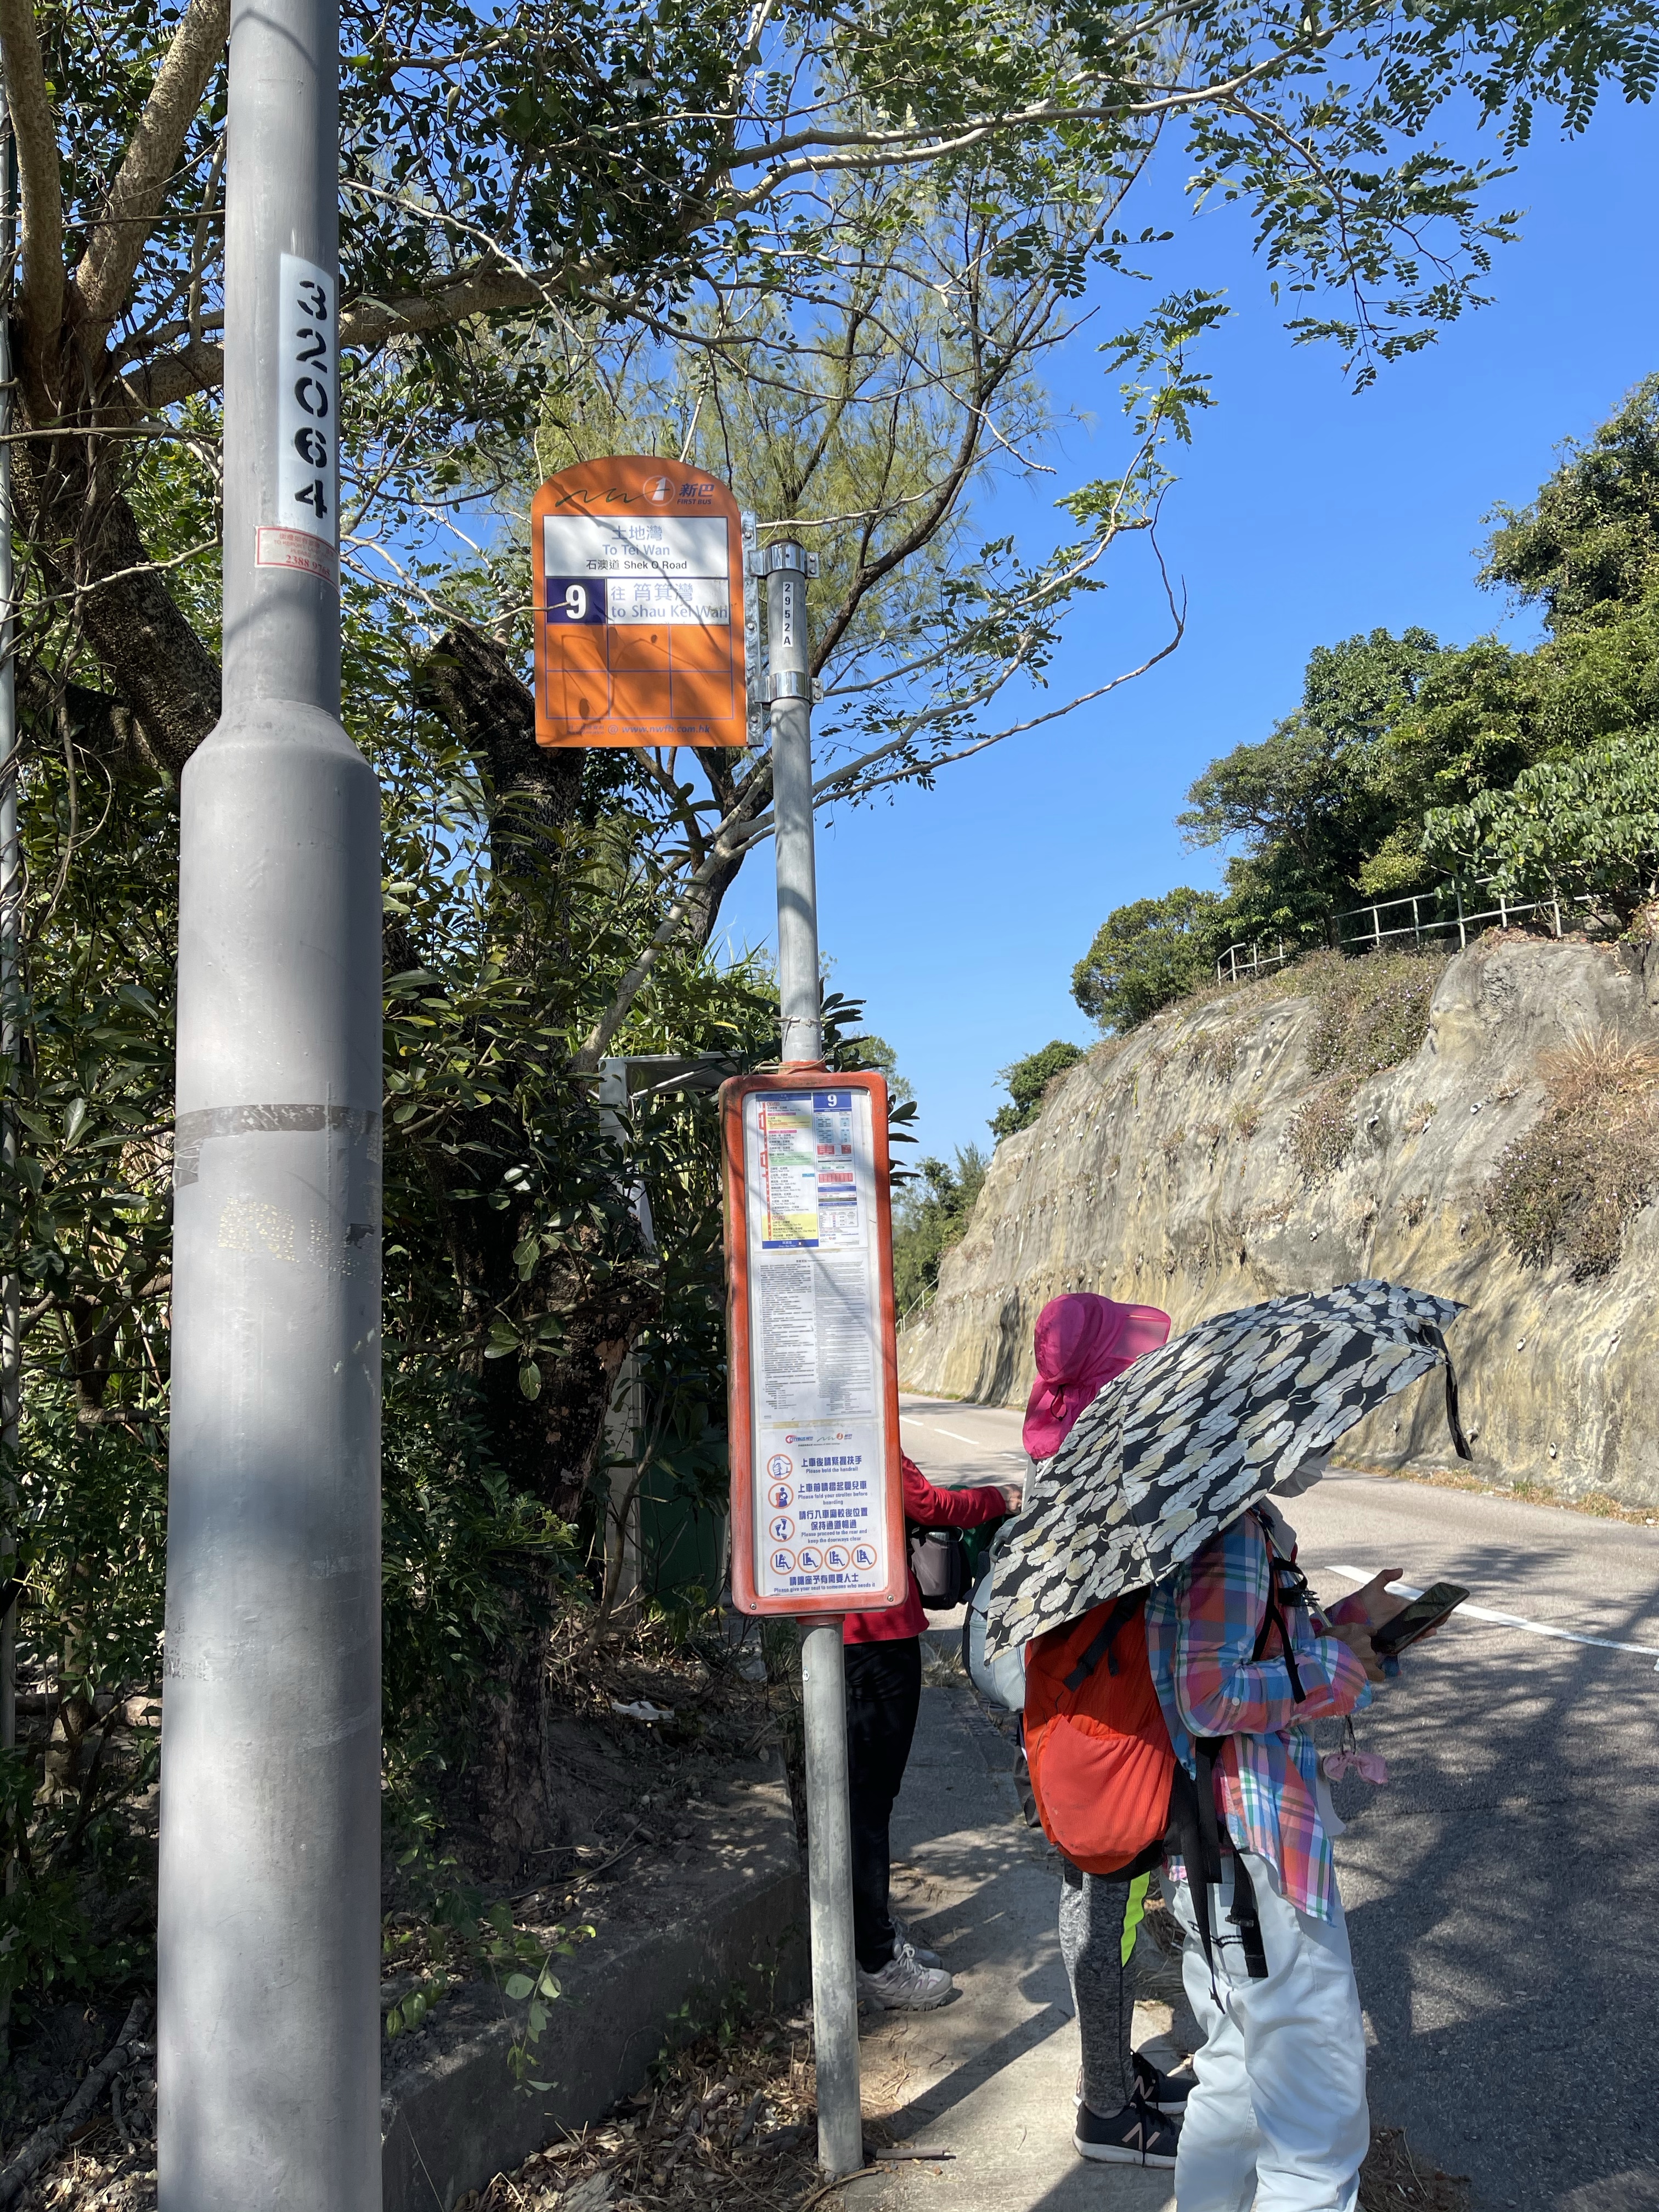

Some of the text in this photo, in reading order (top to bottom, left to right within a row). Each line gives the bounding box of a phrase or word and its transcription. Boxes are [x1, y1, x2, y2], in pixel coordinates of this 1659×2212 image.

[295, 280, 328, 519] 32064
[679, 483, 715, 498] 新巴
[611, 525, 663, 541] 土地灣
[602, 544, 670, 555] To Tei Wan
[286, 555, 309, 567] 2388
[586, 559, 687, 571] 石澳道 Shek O Road
[611, 583, 693, 601] 往 筲箕灣
[565, 584, 587, 619] 9
[612, 605, 728, 618] to Shau Kei Wan
[622, 725, 710, 733] www.nwfb.com.hk
[827, 1094, 837, 1107] 9
[801, 1455, 862, 1468] 上車後請緊握扶手
[798, 1481, 867, 1492] 上車前請摺起嬰兒車
[799, 1508, 868, 1520] 請行入車廂較後位置
[811, 1520, 857, 1531] 保持通道暢通
[789, 1573, 859, 1585] 請讓座予有需要人士
